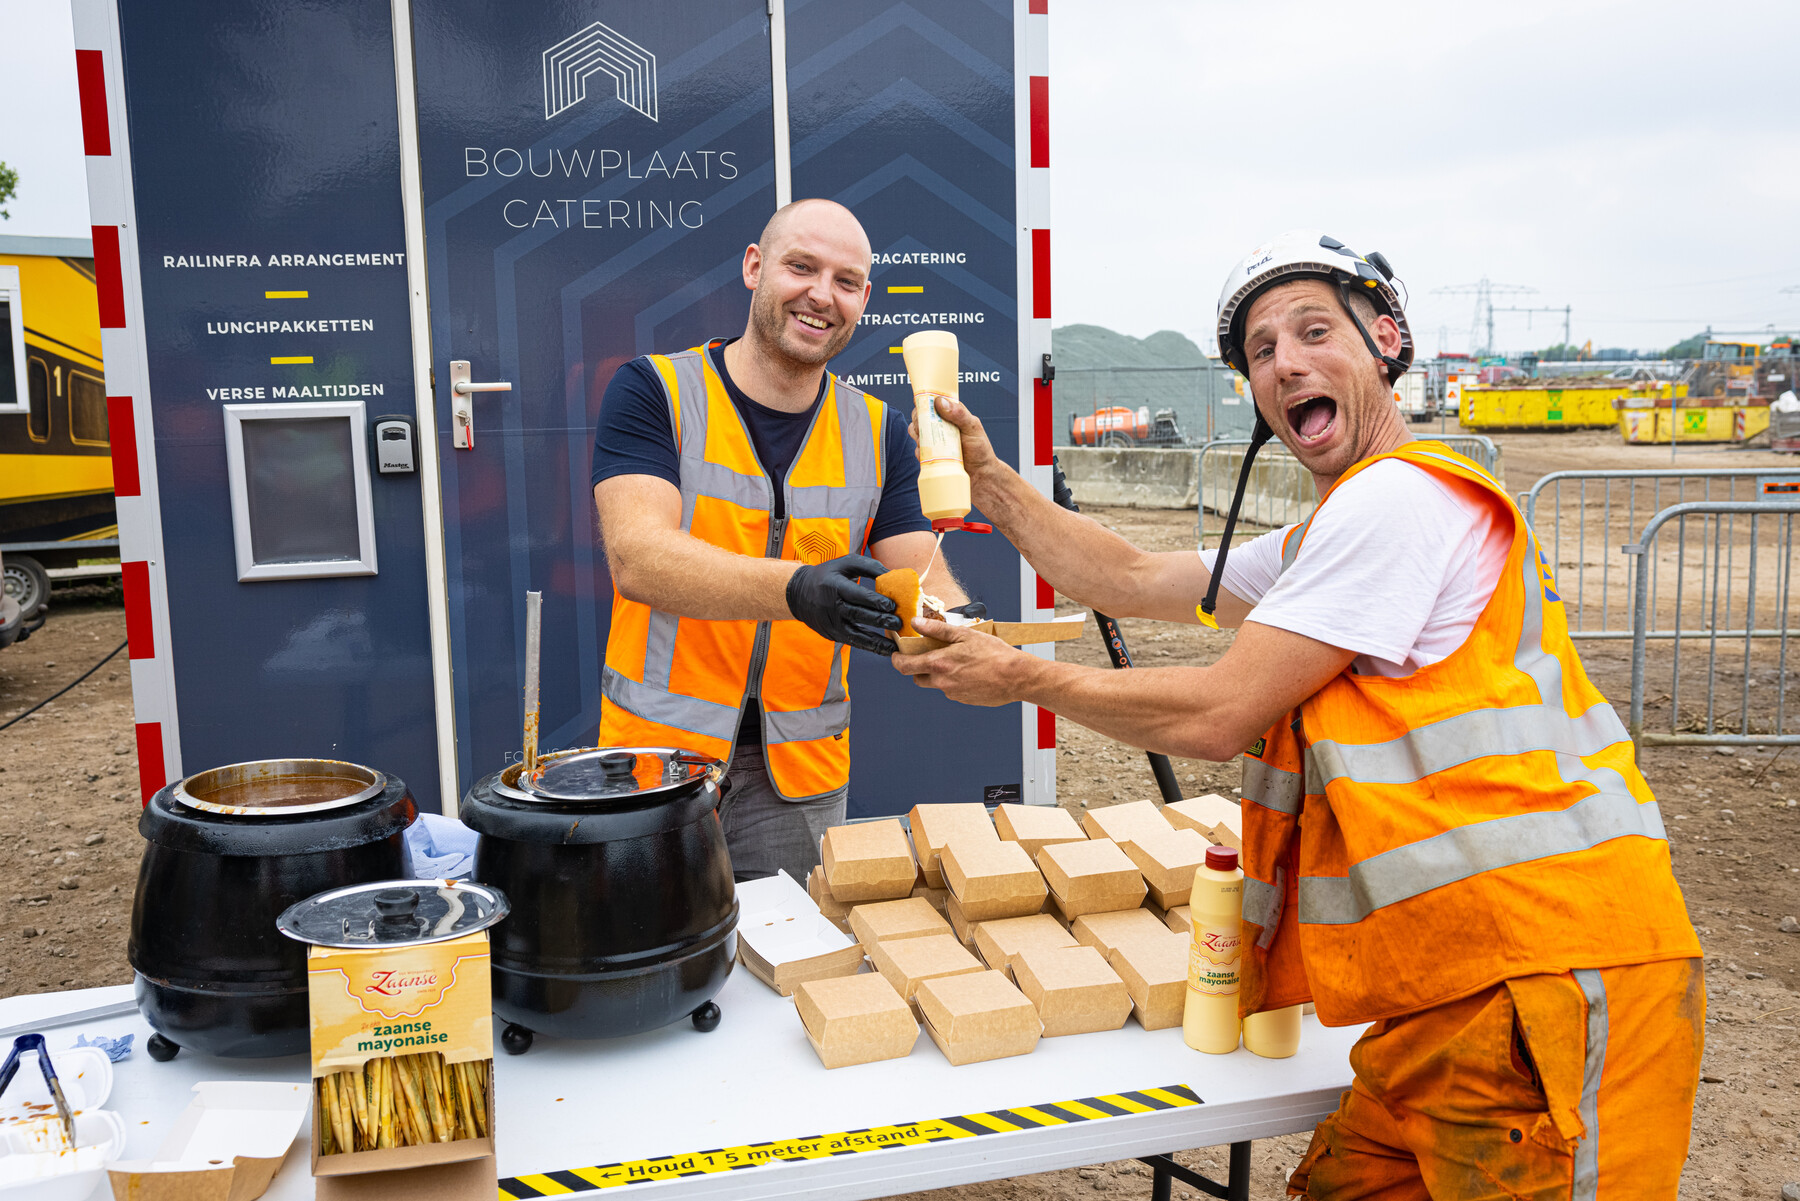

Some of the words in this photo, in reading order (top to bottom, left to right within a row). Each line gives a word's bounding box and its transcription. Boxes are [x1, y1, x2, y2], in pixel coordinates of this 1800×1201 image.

[465, 147, 738, 180] BOUWPLAATS
[503, 199, 703, 229] CATERING
[163, 255, 262, 268] RAILINFRA
[268, 253, 405, 267] ARRANGEMENT
[871, 252, 967, 265] RACATERING
[207, 319, 374, 335] LUNCHPAKKETTEN
[53, 365, 62, 397] 1
[206, 386, 266, 400] VERSE
[272, 383, 385, 398] MAALTIJDEN
[365, 970, 438, 997] Zaanse
[1199, 975, 1240, 987] mayonaise
[373, 1021, 432, 1037] zaanse
[357, 1031, 448, 1053] mayonaise
[628, 1158, 695, 1177] Houd
[725, 1152, 739, 1164] 5
[747, 1143, 821, 1160] meter
[830, 1127, 920, 1150] afstand
